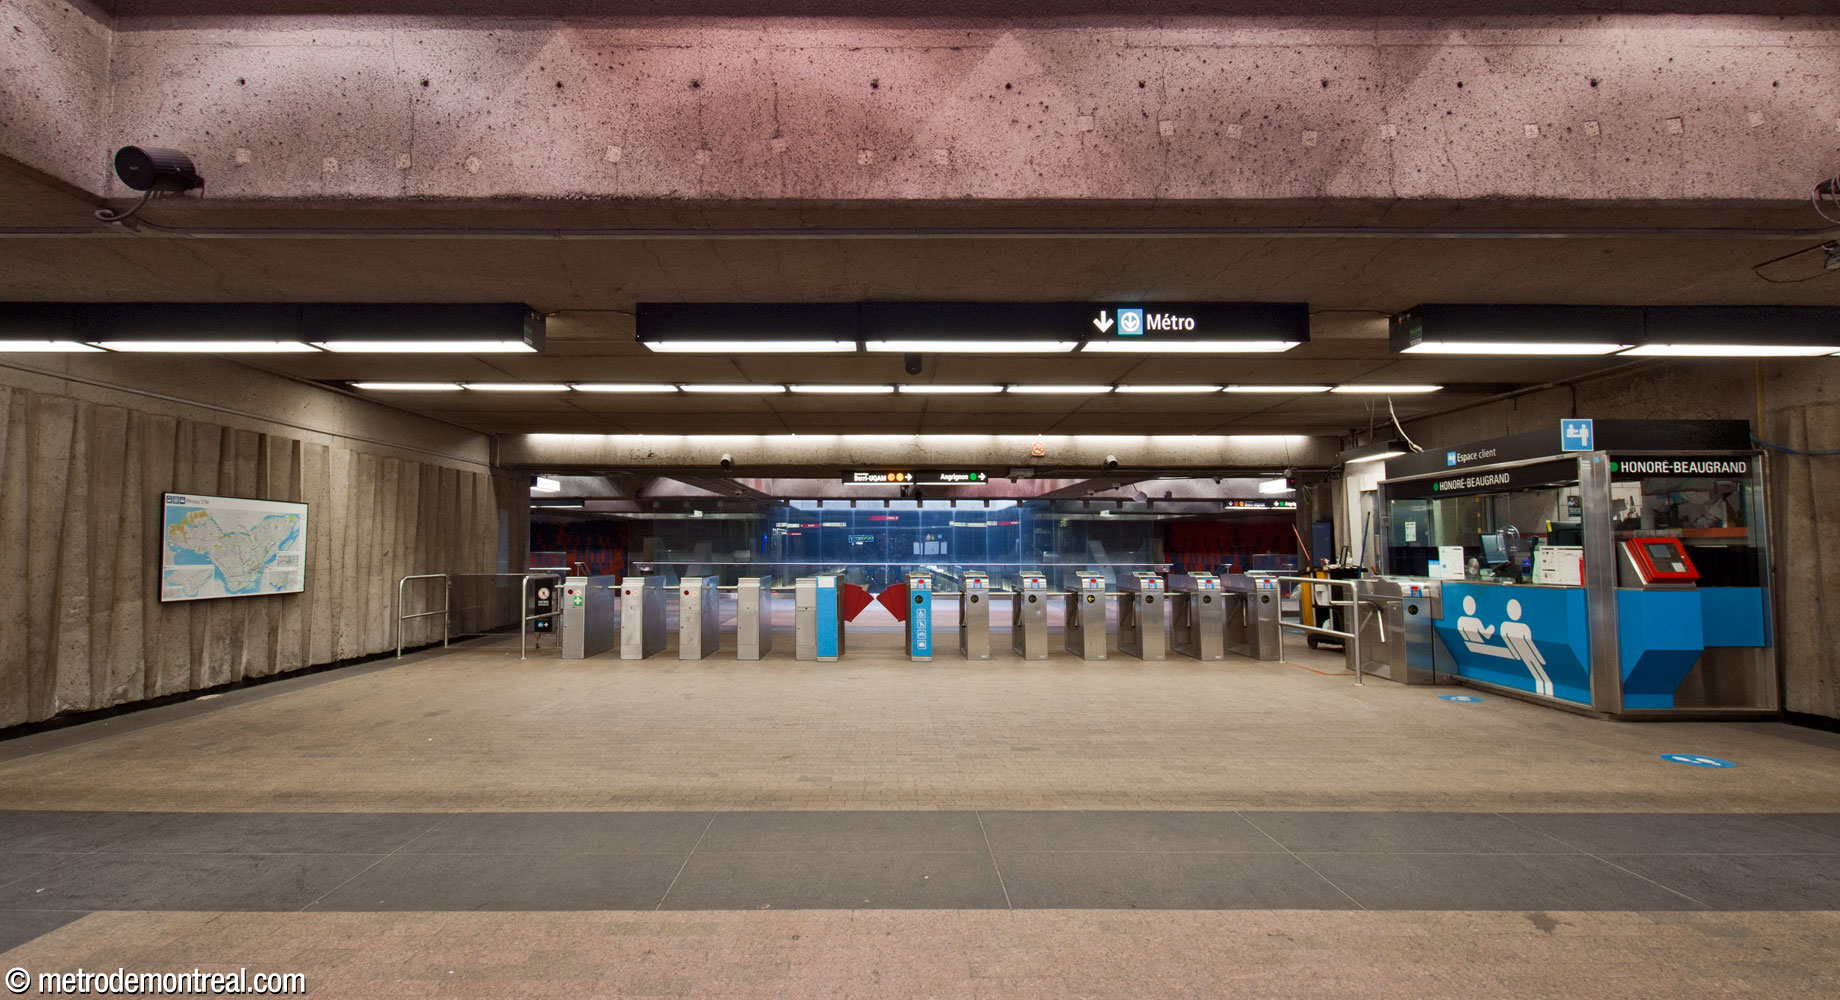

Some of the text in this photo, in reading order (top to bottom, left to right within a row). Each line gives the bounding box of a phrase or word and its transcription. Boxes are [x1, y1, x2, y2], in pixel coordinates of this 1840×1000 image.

[1146, 313, 1195, 330] Métro
[1457, 448, 1497, 463] Espace client
[1621, 460, 1747, 473] HONORÉ-BEAUGRAND
[940, 473, 969, 481] Angrignon
[1439, 472, 1510, 490] HONORÉ-BEAUGRAND
